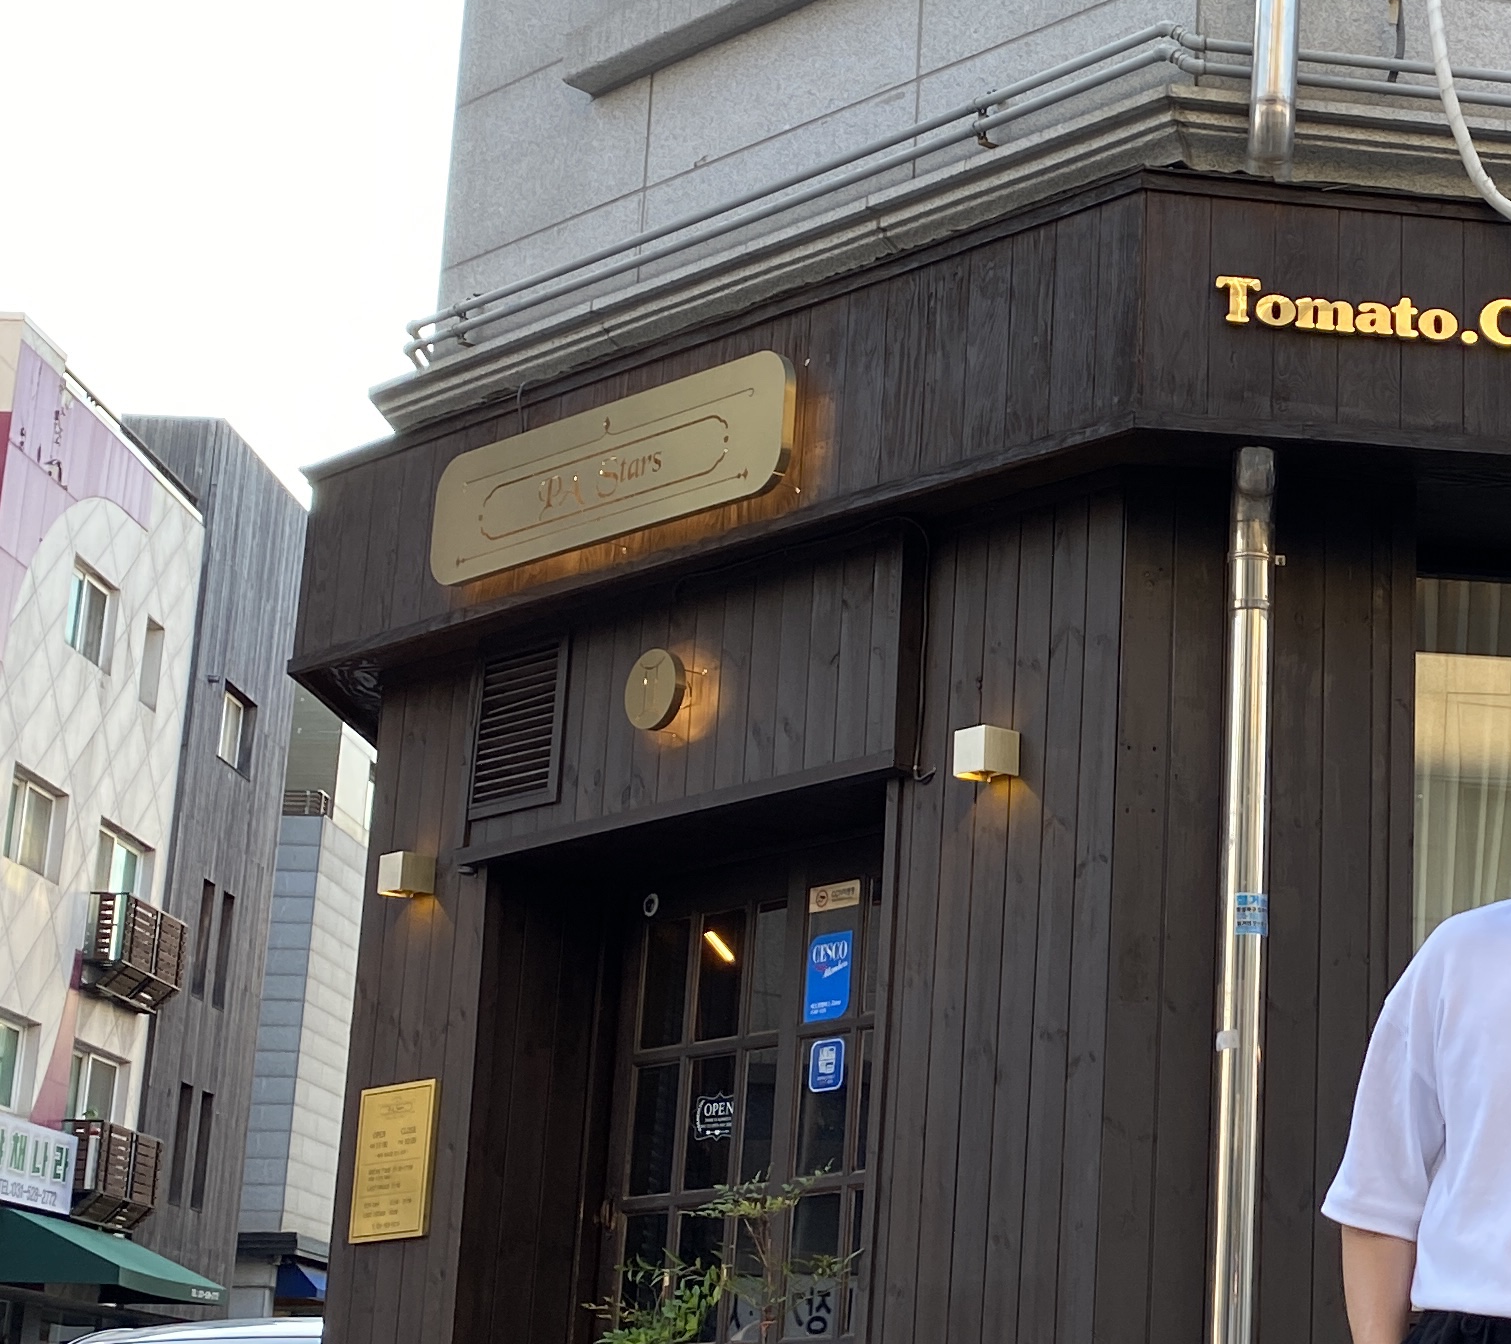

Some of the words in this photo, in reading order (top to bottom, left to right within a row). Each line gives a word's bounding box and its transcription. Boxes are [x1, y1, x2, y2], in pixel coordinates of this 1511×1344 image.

[597, 449, 664, 499] Stars
[812, 940, 848, 964] CESCO
[703, 1101, 735, 1117] OPEN
[0, 1129, 70, 1183] 채나라
